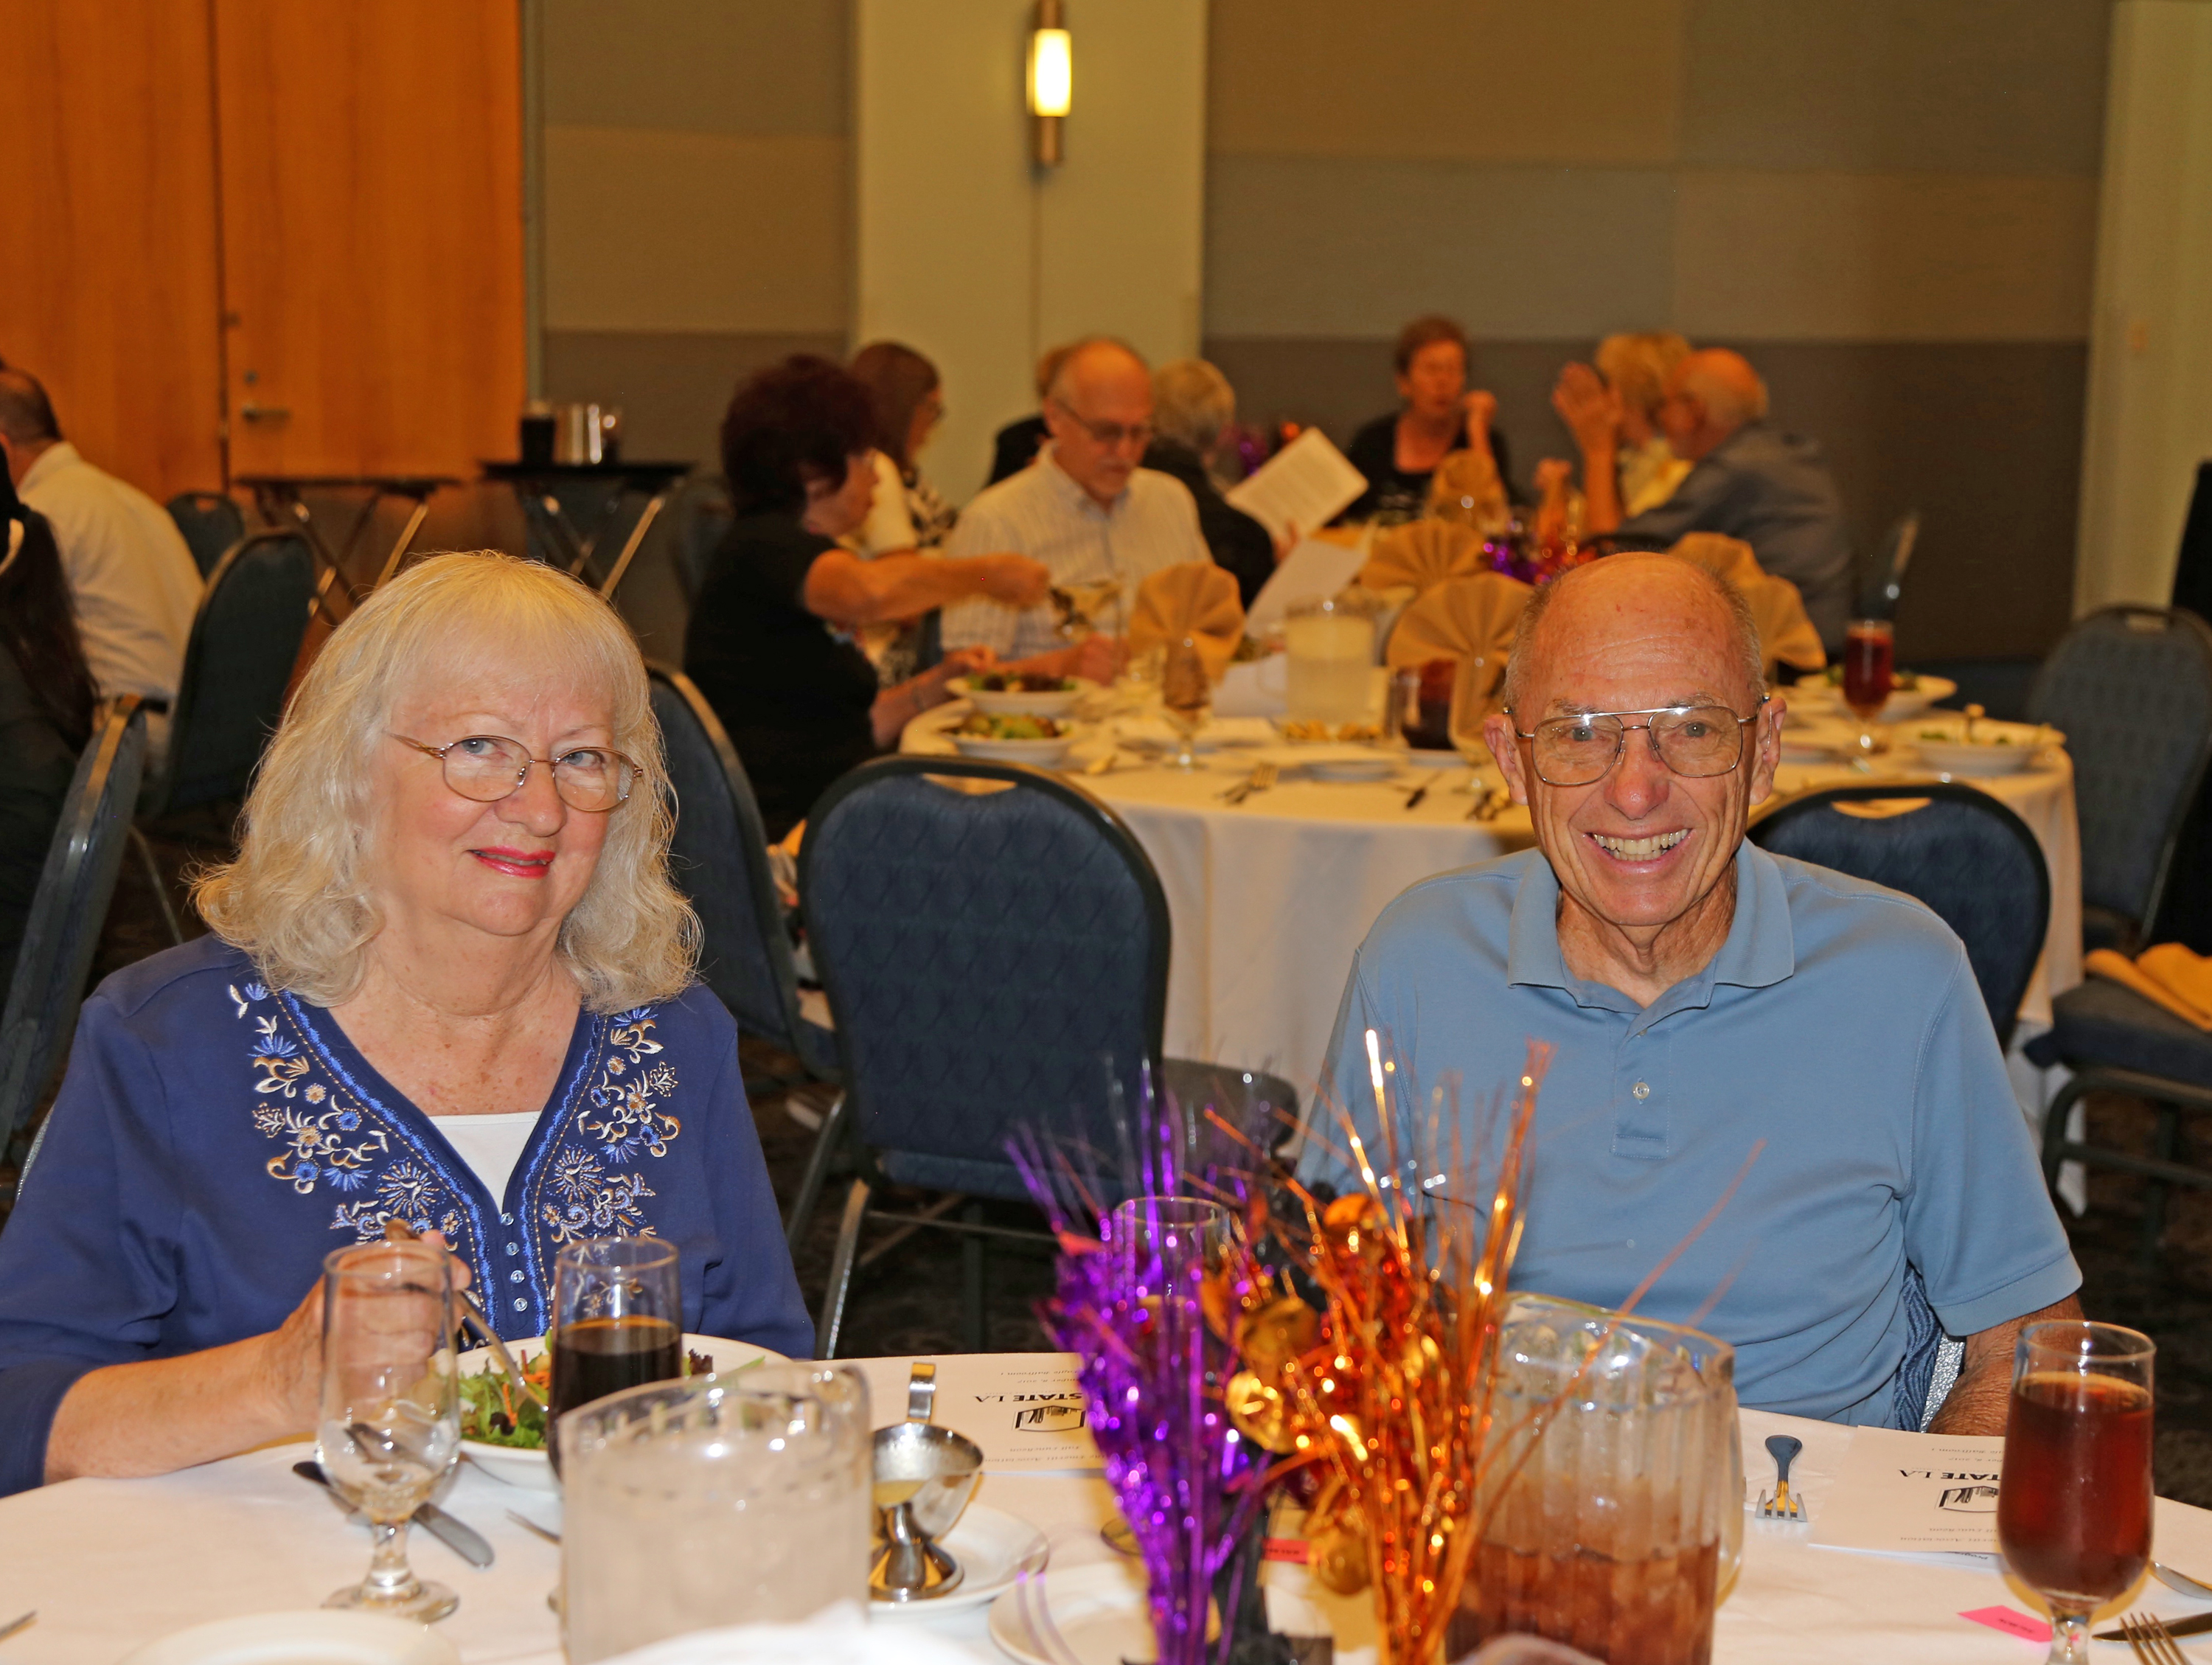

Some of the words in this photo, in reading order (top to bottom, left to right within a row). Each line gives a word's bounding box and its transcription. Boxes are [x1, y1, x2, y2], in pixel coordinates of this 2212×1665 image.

[1013, 1392, 1083, 1402] STATE
[1898, 1469, 1933, 1478] LA
[1941, 1472, 2001, 1481] TATE
